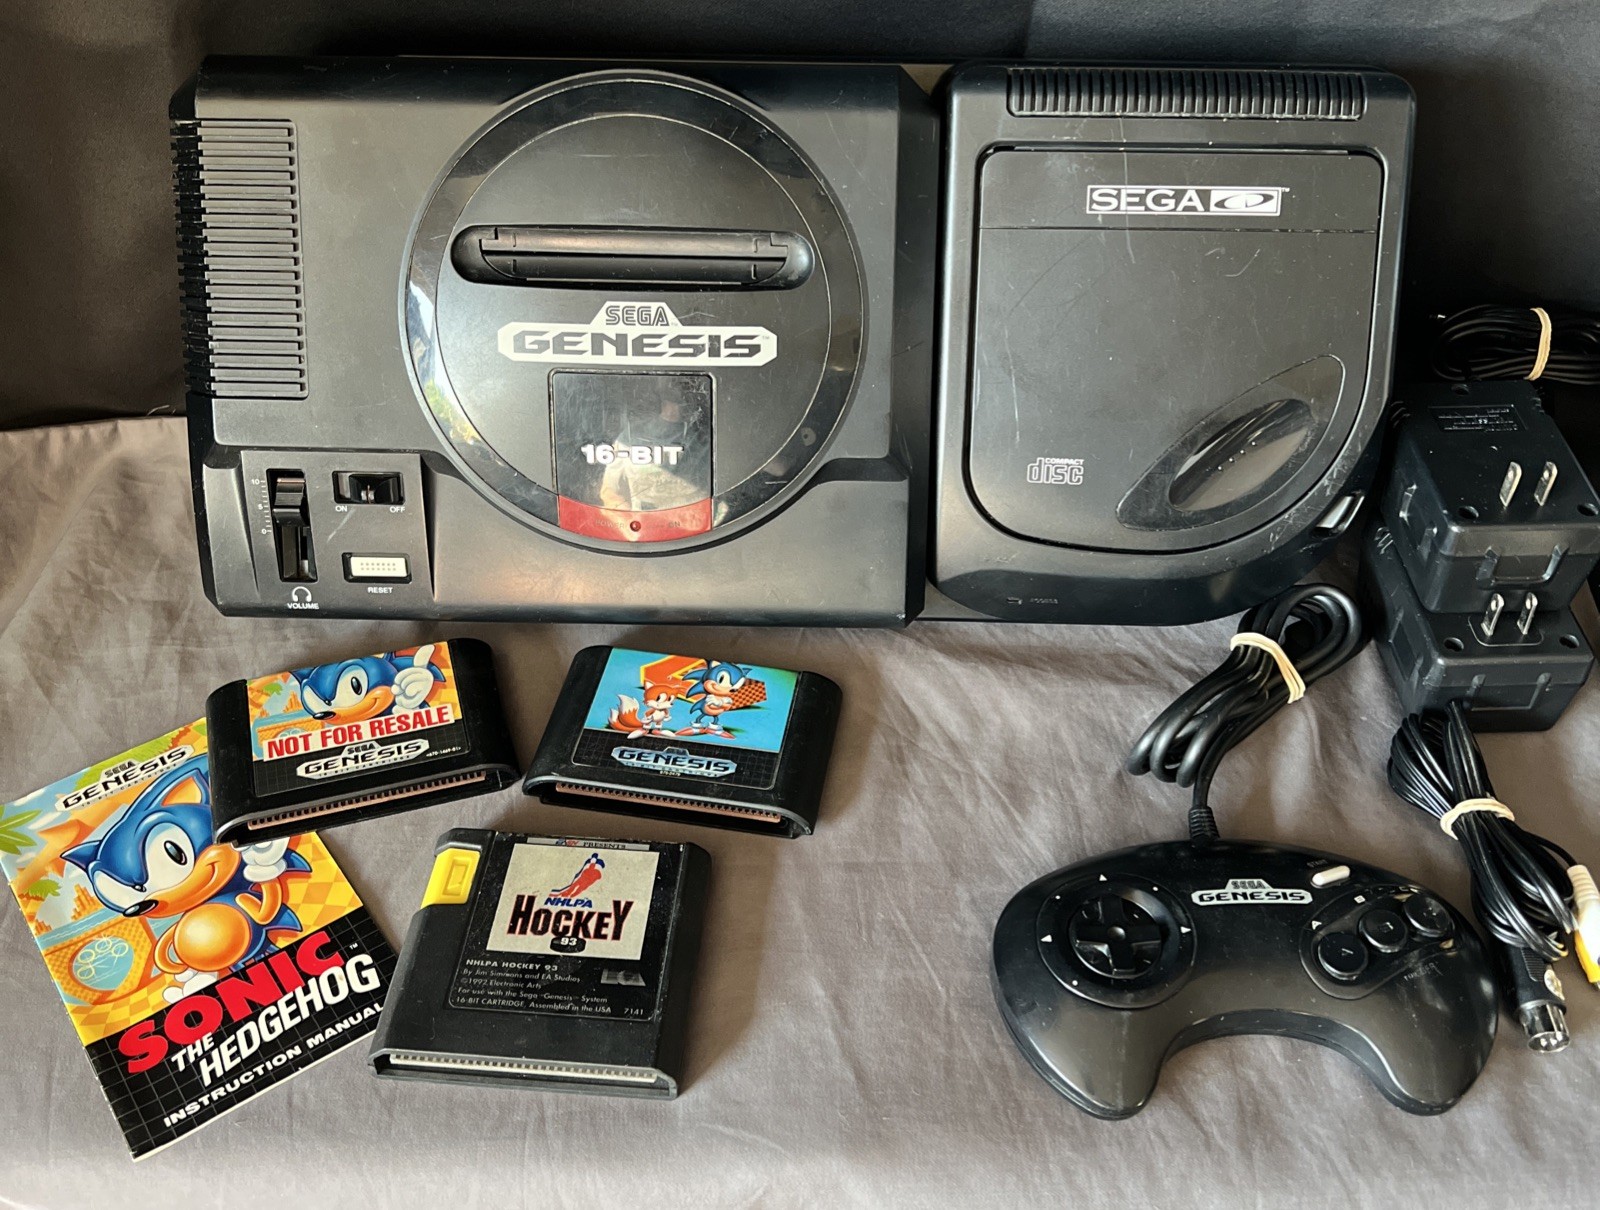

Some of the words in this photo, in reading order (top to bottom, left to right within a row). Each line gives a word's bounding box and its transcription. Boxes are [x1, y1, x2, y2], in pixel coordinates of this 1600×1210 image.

[1091, 188, 1205, 212] SEGA
[605, 305, 669, 326] SEGA
[513, 330, 762, 358] GENESIS
[580, 444, 684, 465] 16-BIT
[1045, 457, 1084, 466] COMPACT
[335, 505, 348, 513] ON
[389, 505, 405, 513] OFF
[367, 586, 393, 594] RESET
[287, 602, 319, 610] VOLUME
[267, 733, 313, 759] NOT
[321, 723, 364, 745] FOR
[370, 706, 450, 737] RESALE
[348, 743, 375, 754] SEGA
[304, 741, 424, 774] GENESIS
[618, 749, 730, 772] GENESIS
[105, 761, 136, 779] SEGA
[62, 747, 187, 809] GENESIS
[583, 841, 627, 849] PRESENTS
[1231, 880, 1265, 889] SEGA
[1198, 891, 1305, 902] GENESIS
[544, 897, 592, 908] NHLPA
[507, 894, 634, 941] HOCKEY
[560, 937, 577, 946] 93
[466, 959, 498, 967] NHLPA
[502, 962, 541, 970] HOCKEY
[490, 970, 522, 978] Simmons
[489, 980, 524, 988] Electronic
[118, 930, 345, 1074] SONIC
[582, 995, 608, 1003] System
[529, 1001, 569, 1010] Assembled
[624, 1007, 643, 1015] 7141
[200, 954, 381, 1087] HEDGEHOG
[171, 1034, 215, 1072] THE
[164, 1045, 303, 1128] INSTRUCTION
[306, 1002, 383, 1047] MANUAL
